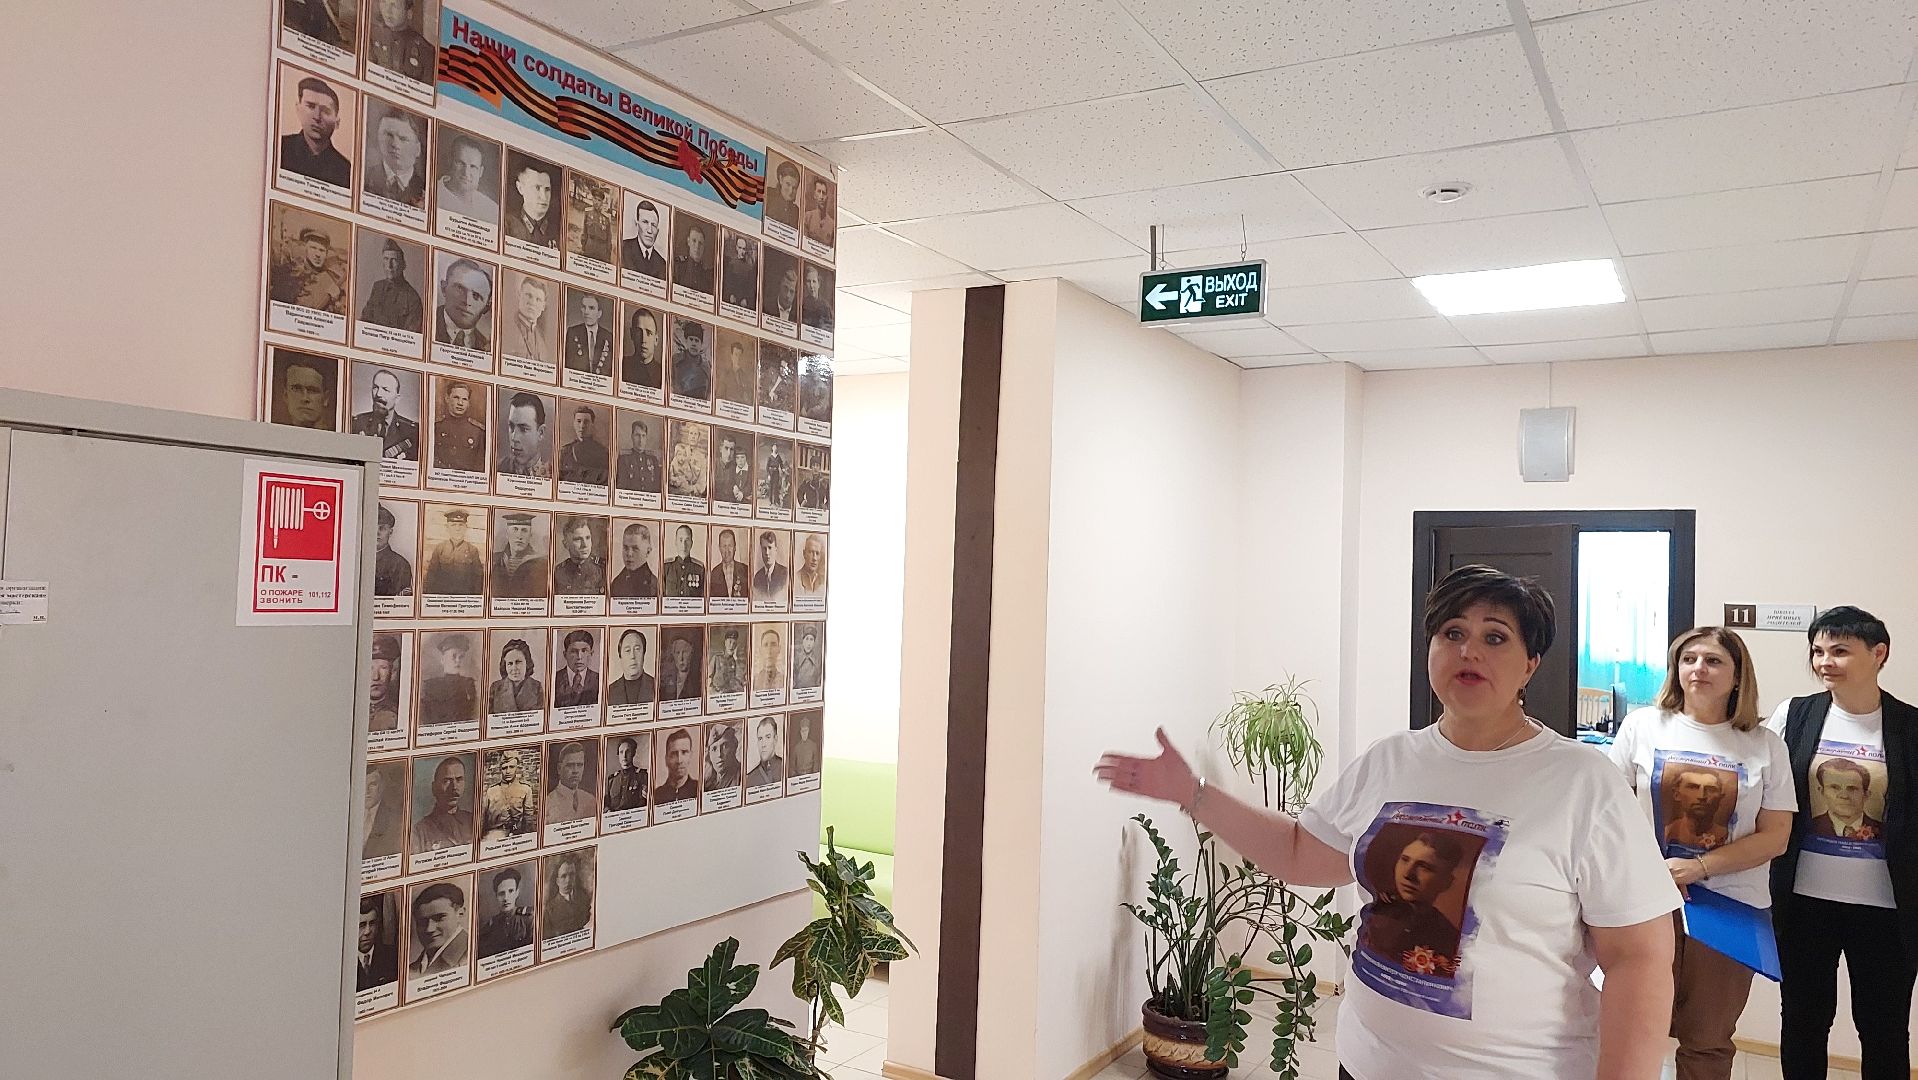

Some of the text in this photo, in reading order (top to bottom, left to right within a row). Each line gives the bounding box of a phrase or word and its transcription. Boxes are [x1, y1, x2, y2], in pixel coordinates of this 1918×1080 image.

[452, 15, 758, 173] Наши солдаты Великой Победы
[1205, 271, 1258, 293] ВЫХОД
[1215, 292, 1248, 309] EXIT
[260, 564, 286, 583] ПК
[268, 589, 303, 597] ПОЖАРЕ
[308, 591, 331, 599] 101,112
[1731, 607, 1751, 624] 11
